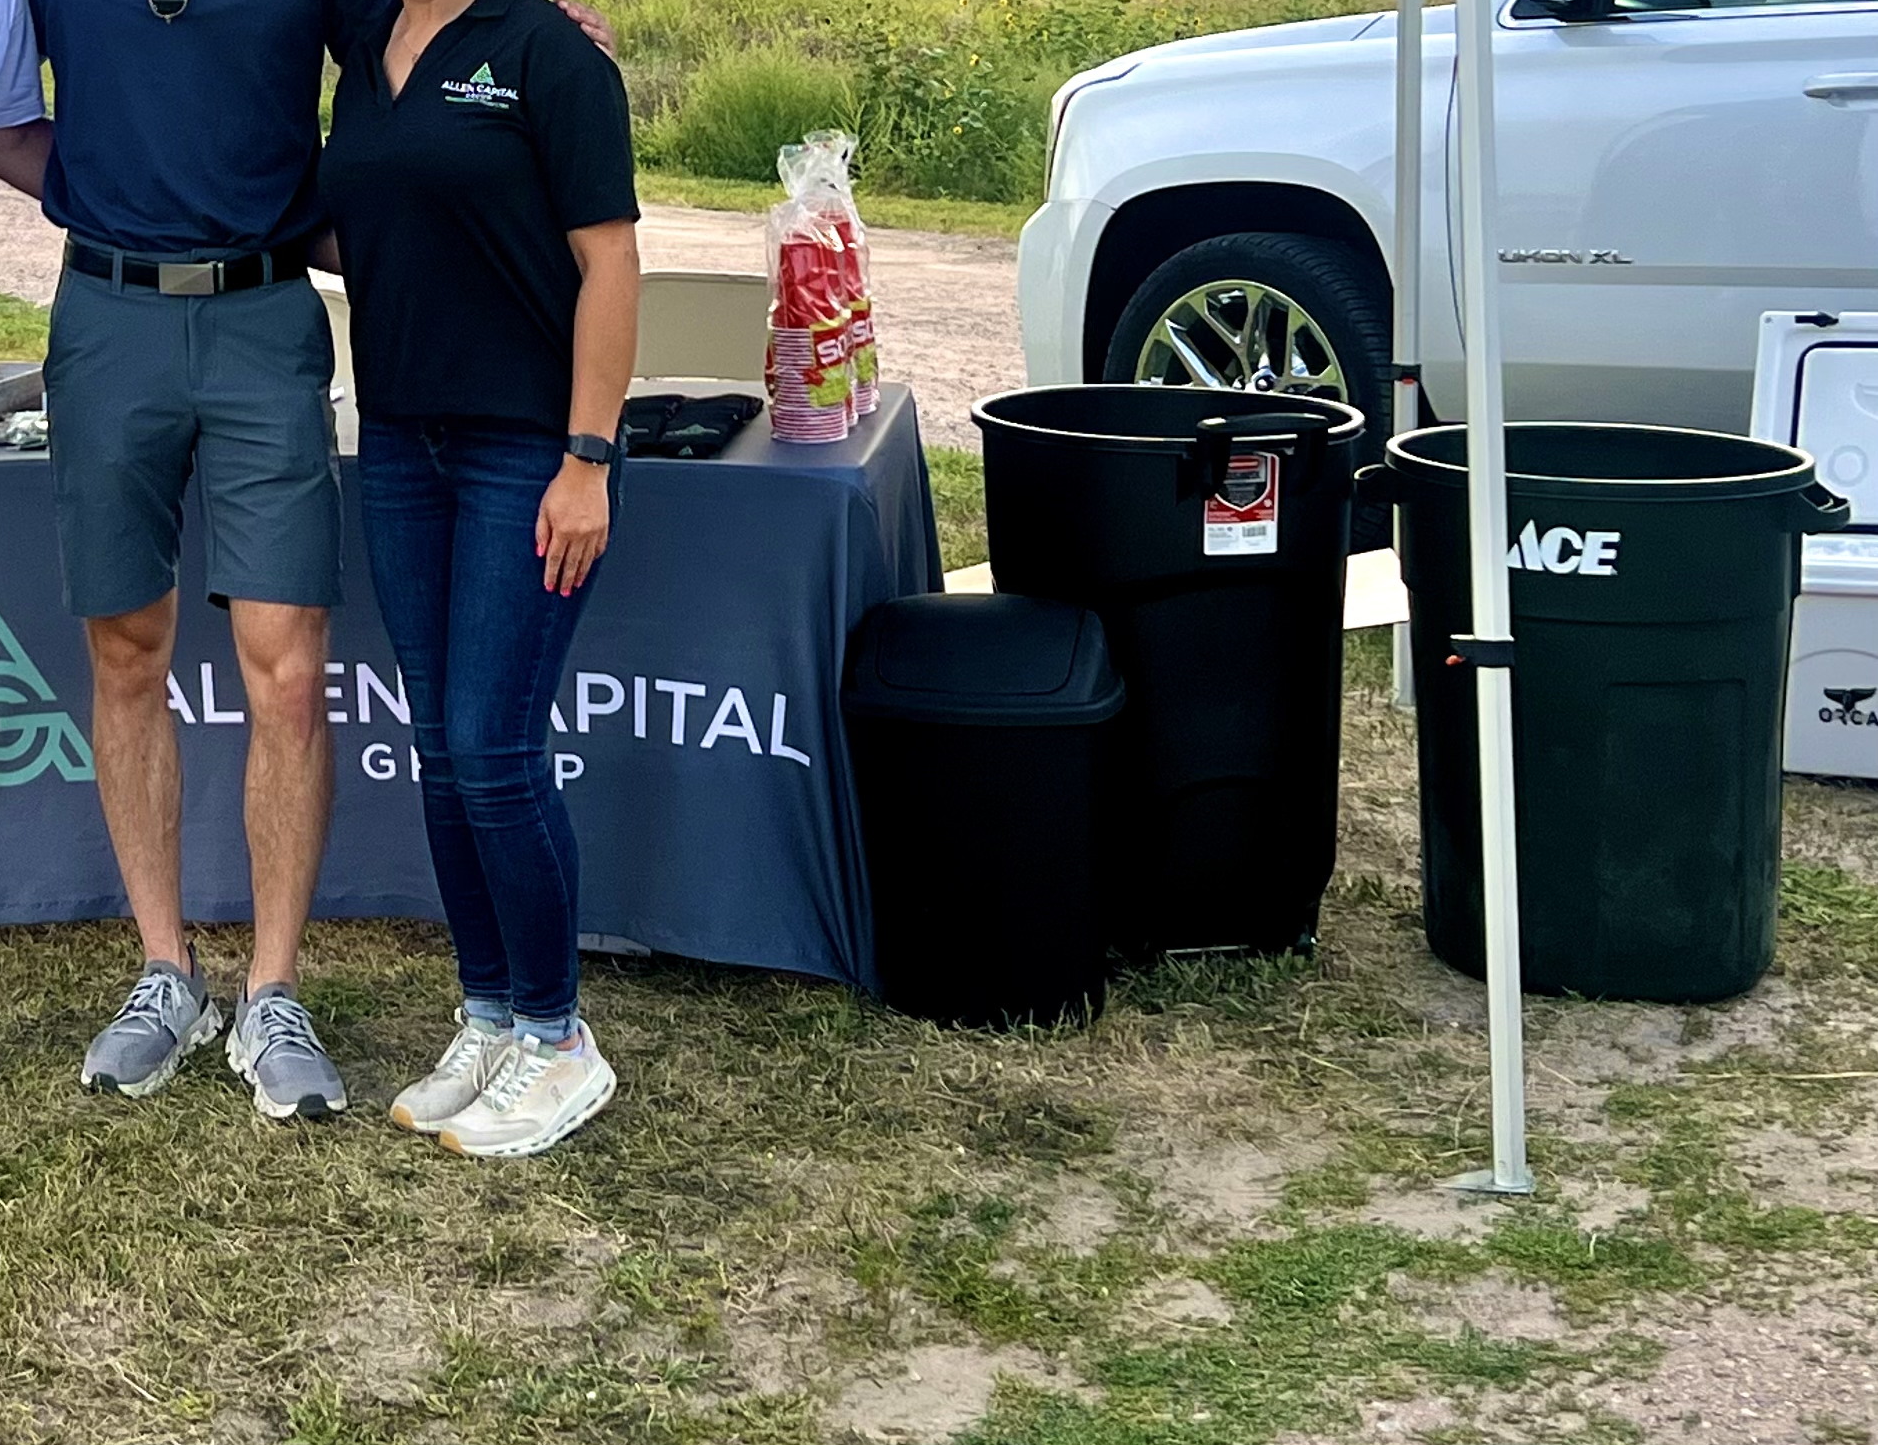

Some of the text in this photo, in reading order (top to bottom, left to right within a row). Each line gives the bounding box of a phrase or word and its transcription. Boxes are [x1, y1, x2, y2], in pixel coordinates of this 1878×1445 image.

[441, 80, 475, 93] ALLEN
[476, 84, 519, 100] CAPITAL
[1497, 248, 1635, 264] UKON XL
[1505, 518, 1621, 575] ACE
[549, 670, 811, 768] PITAL
[1818, 707, 1878, 727] ORCA
